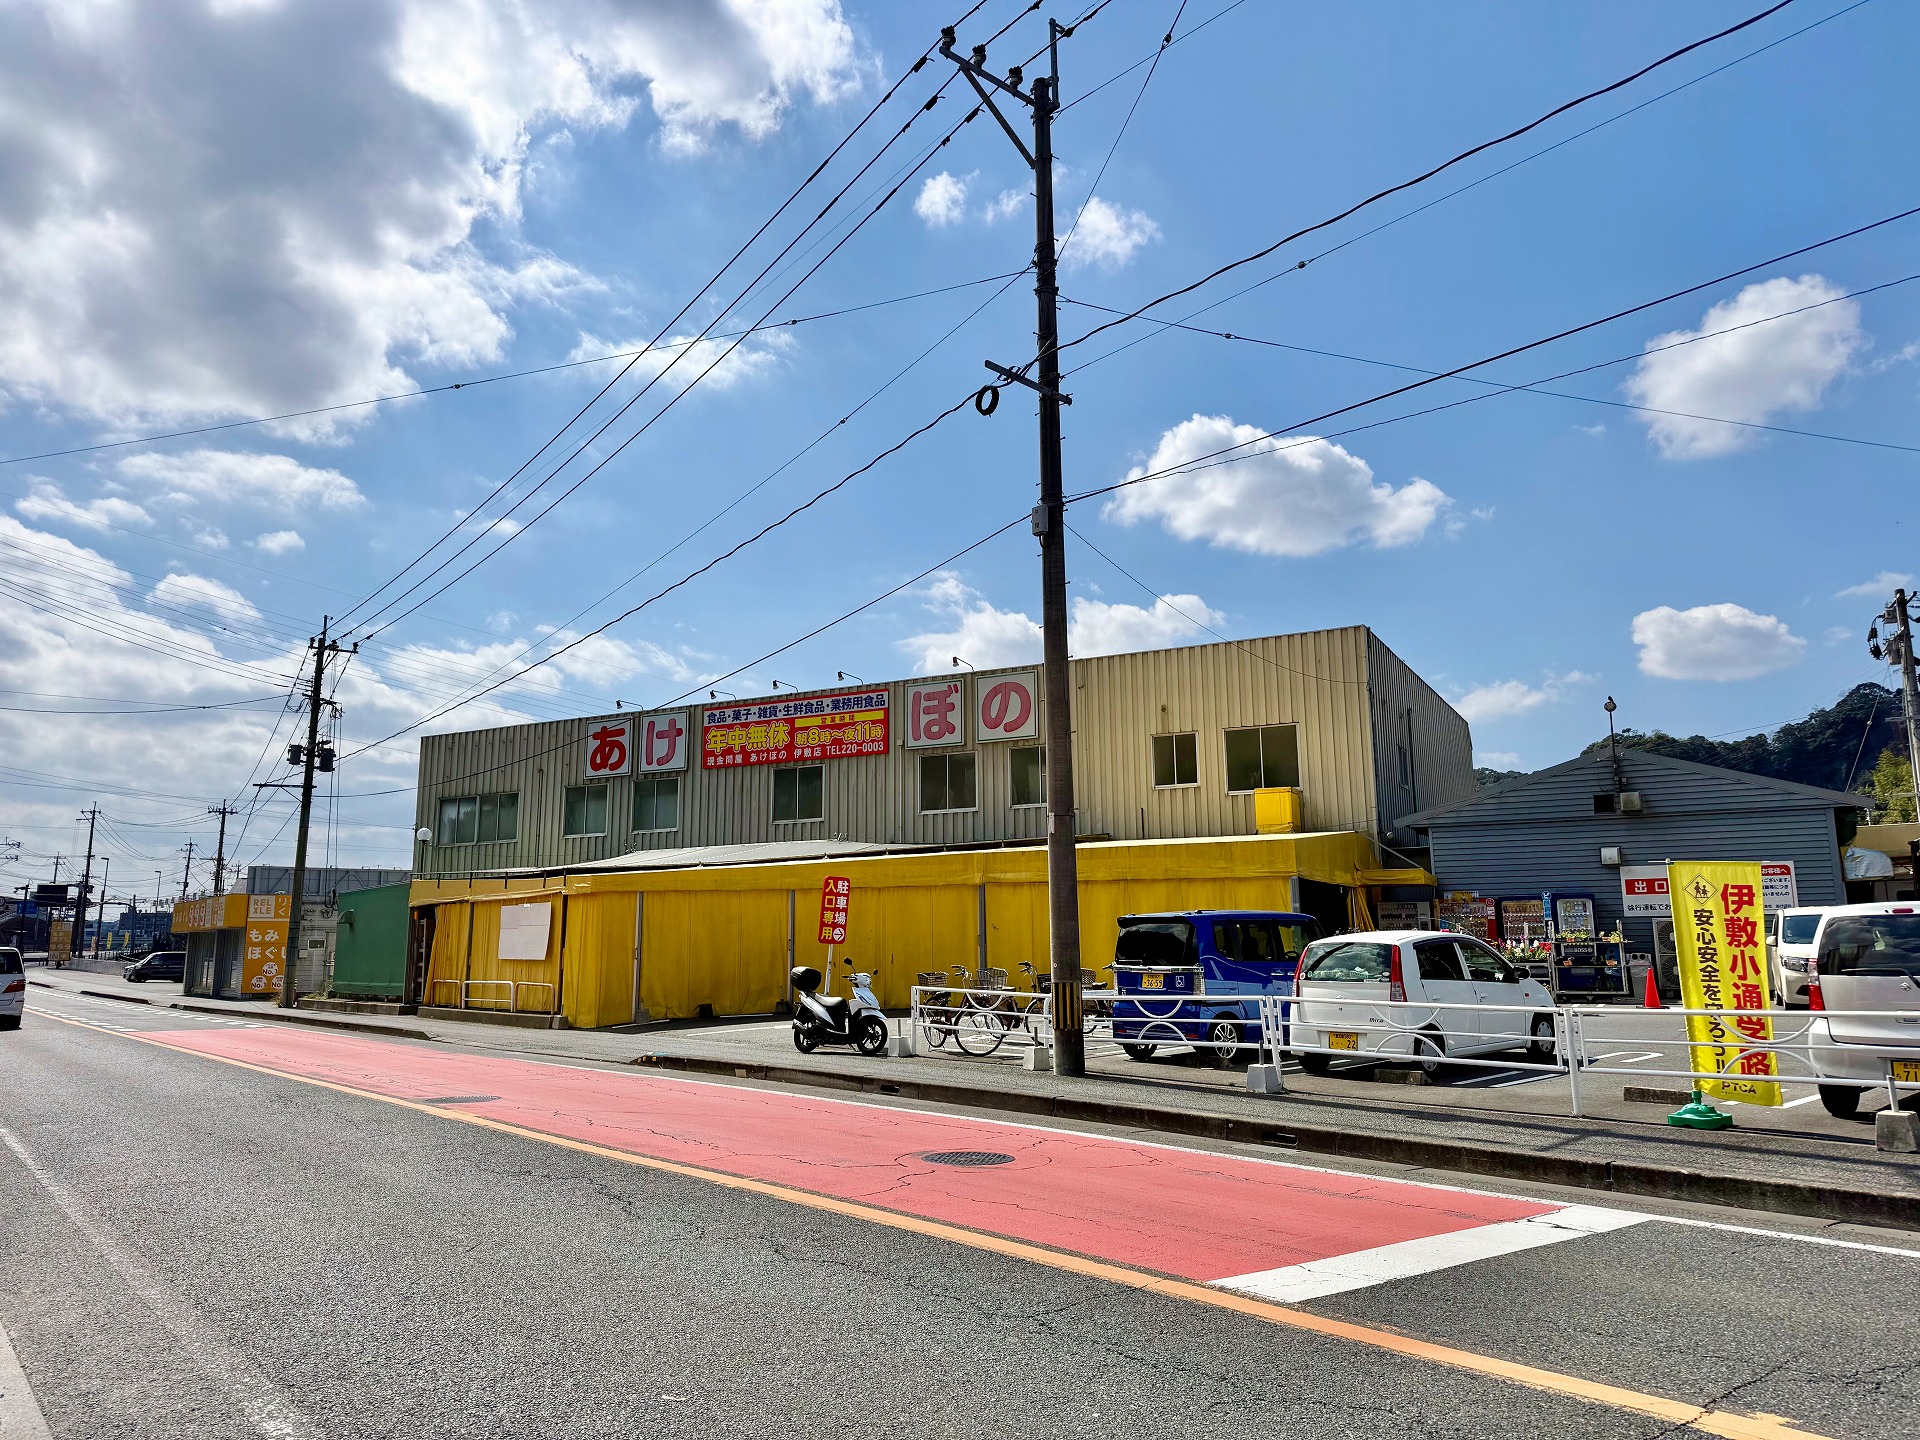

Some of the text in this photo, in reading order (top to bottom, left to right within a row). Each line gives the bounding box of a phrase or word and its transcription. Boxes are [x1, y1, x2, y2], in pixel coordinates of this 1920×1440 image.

[705, 721, 790, 754] 年中無休
[706, 753, 743, 766] 現金問屋
[749, 751, 787, 763] あけぼの
[793, 747, 822, 759] 伊敷店
[1634, 880, 1668, 893] 出口
[252, 906, 272, 915] XLE
[253, 898, 272, 907] REL
[821, 880, 836, 940] 入口専用
[834, 880, 849, 925] 駐車場
[249, 928, 279, 943] もみ
[1720, 883, 1771, 1083] 伊敷小通学路
[1721, 1081, 1757, 1095] PTCA
